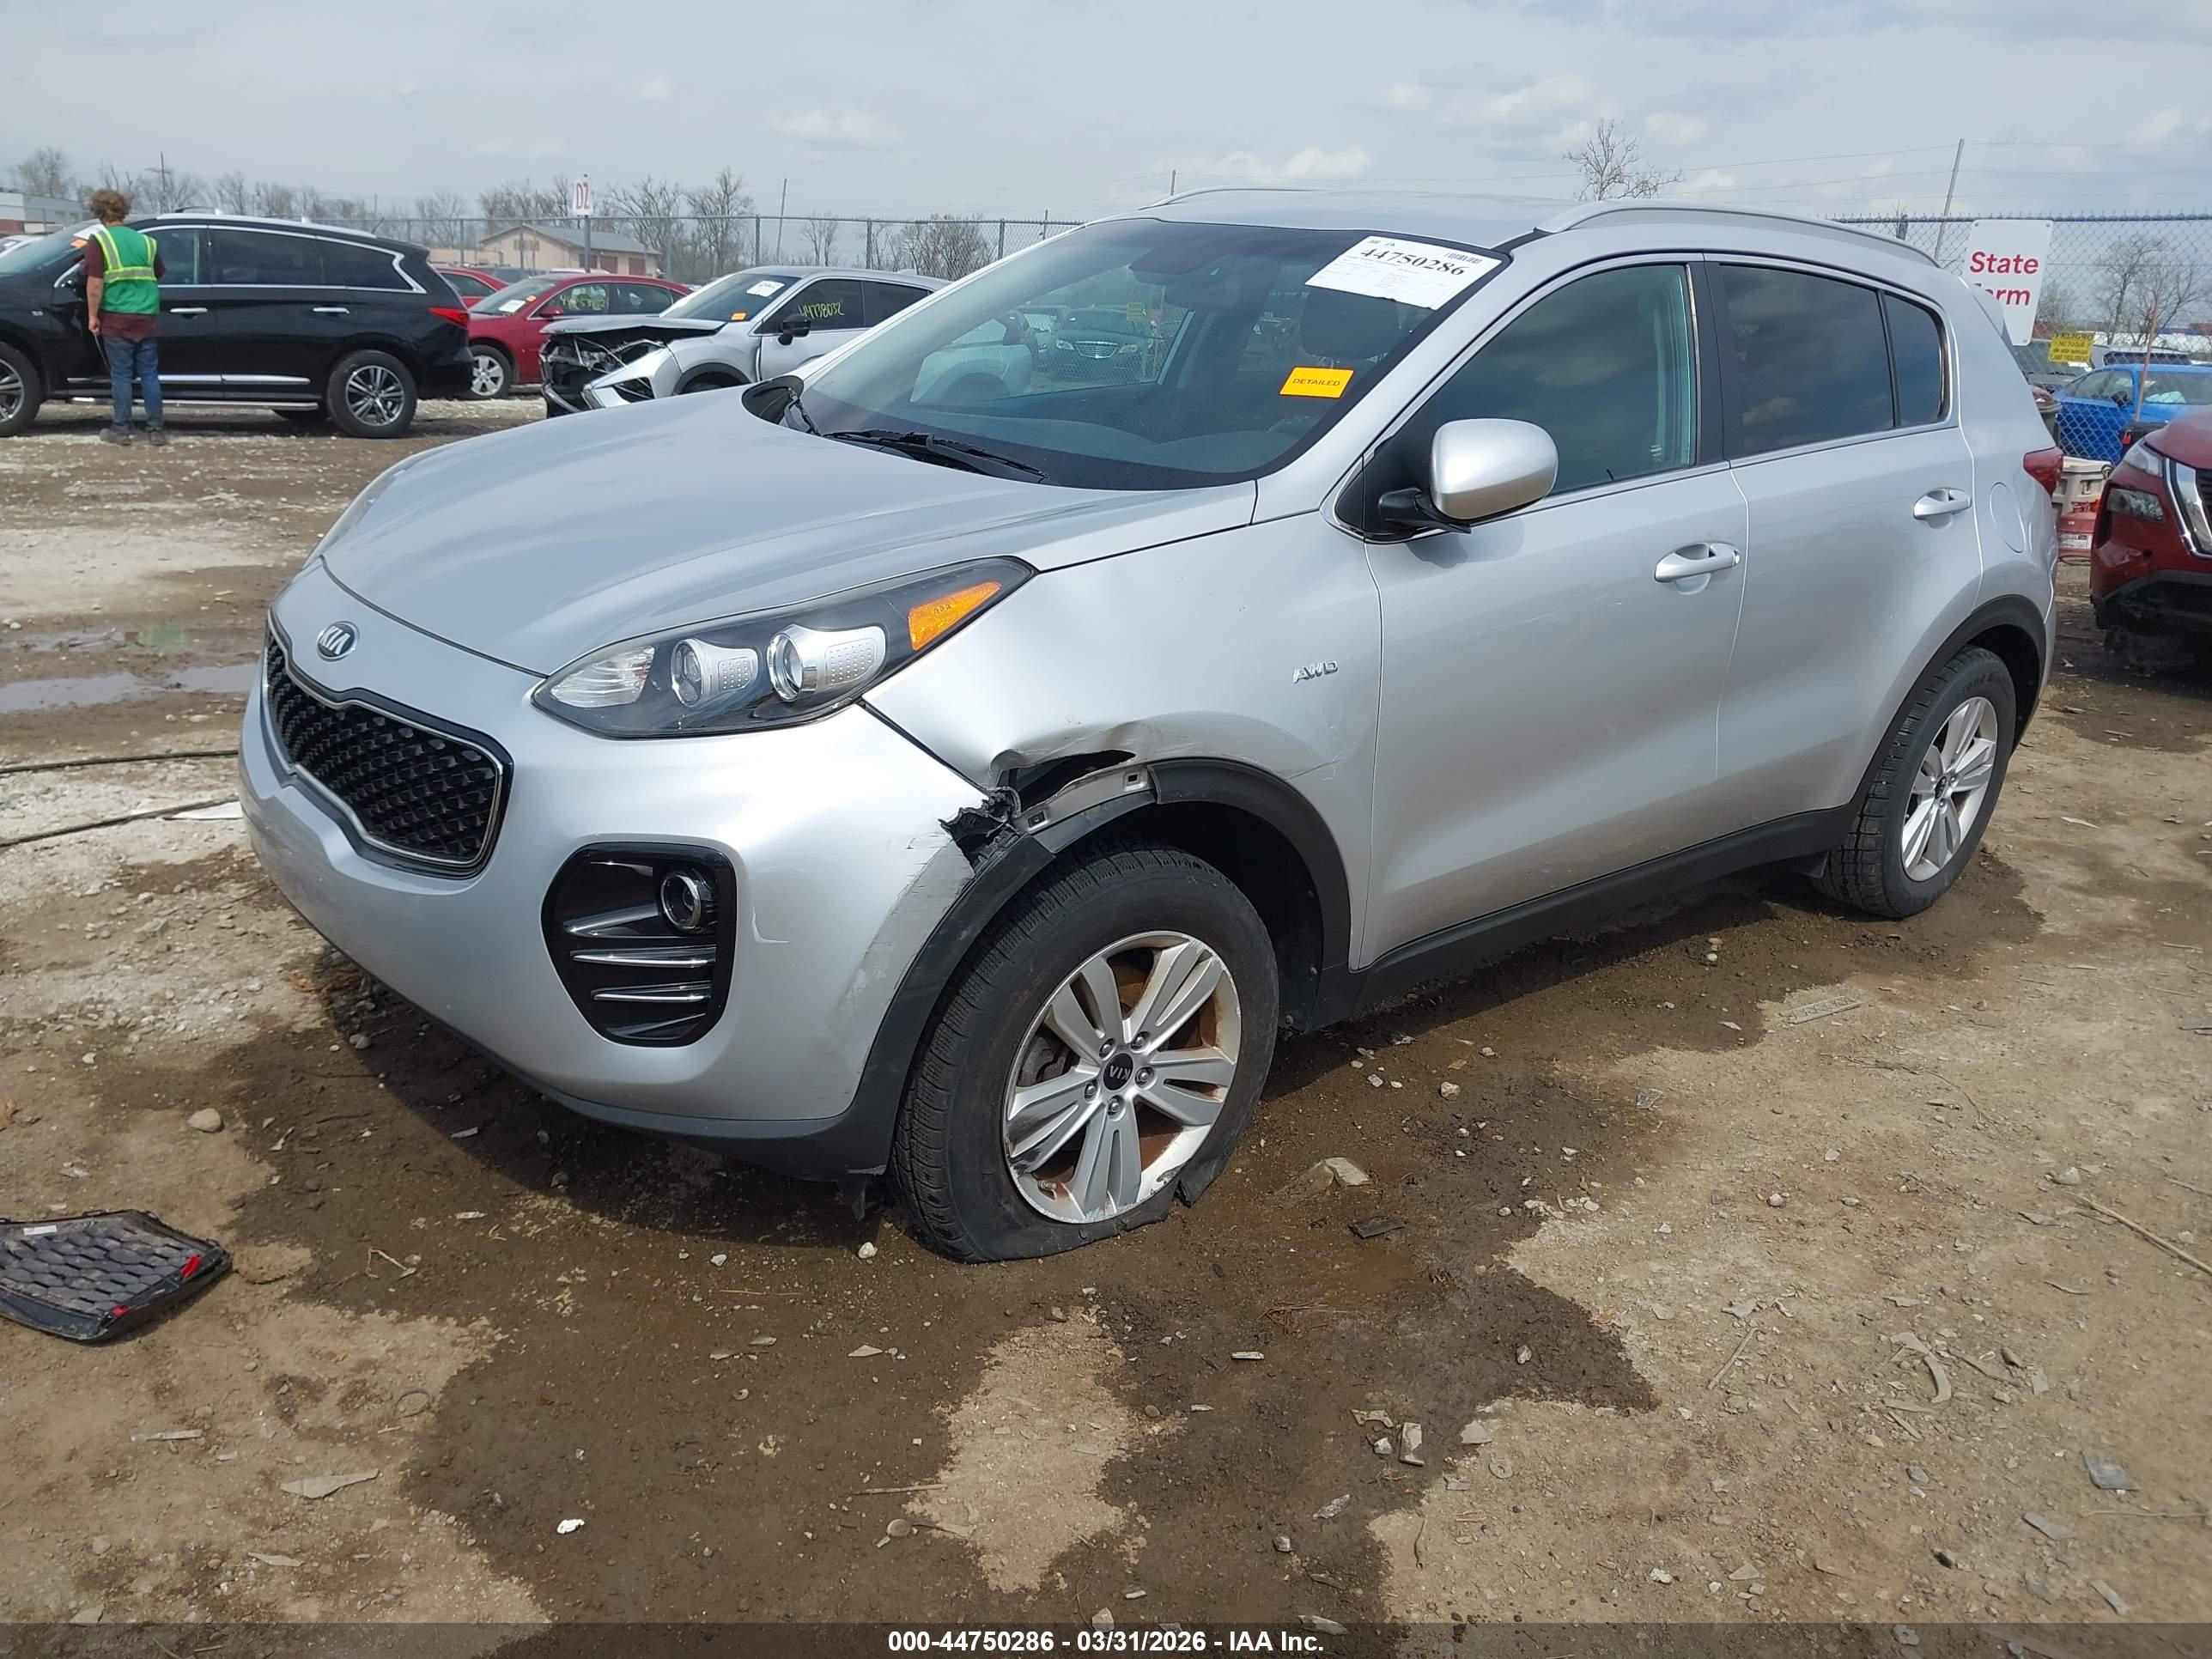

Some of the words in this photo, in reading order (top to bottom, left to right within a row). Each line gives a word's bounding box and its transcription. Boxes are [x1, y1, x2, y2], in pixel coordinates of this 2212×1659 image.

[1361, 248, 1468, 275] 44750286
[1970, 252, 2039, 274] State
[1974, 283, 2031, 306] rm
[1292, 378, 1340, 386] DETAILED
[1292, 660, 1339, 684] AWD
[1109, 1065, 1131, 1080] KIA
